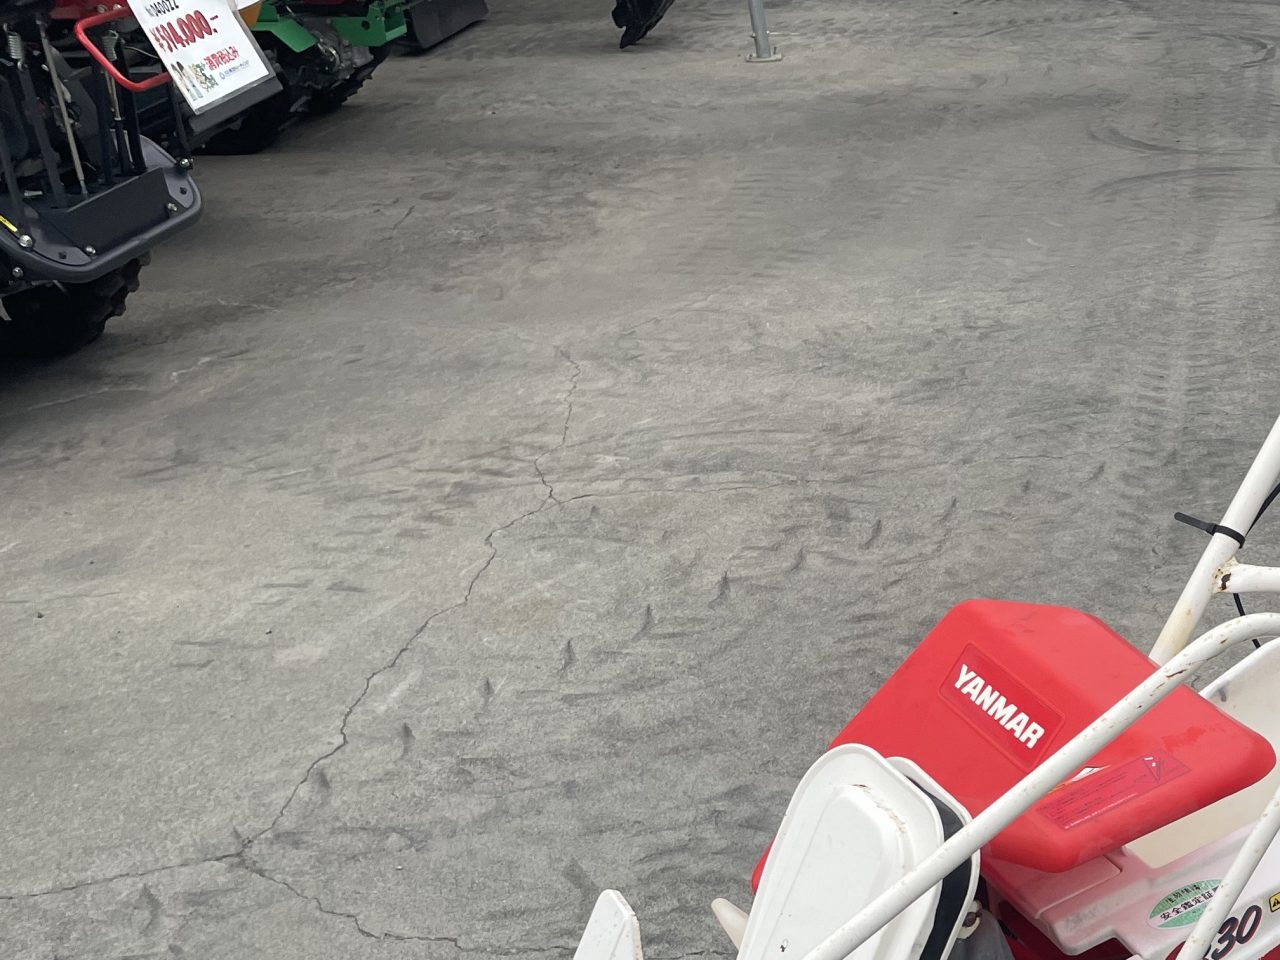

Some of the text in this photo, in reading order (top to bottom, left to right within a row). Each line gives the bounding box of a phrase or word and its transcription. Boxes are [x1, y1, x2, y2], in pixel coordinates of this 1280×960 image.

[954, 663, 1046, 749] YANMAR
[1160, 885, 1219, 921] 安全鑑定証
